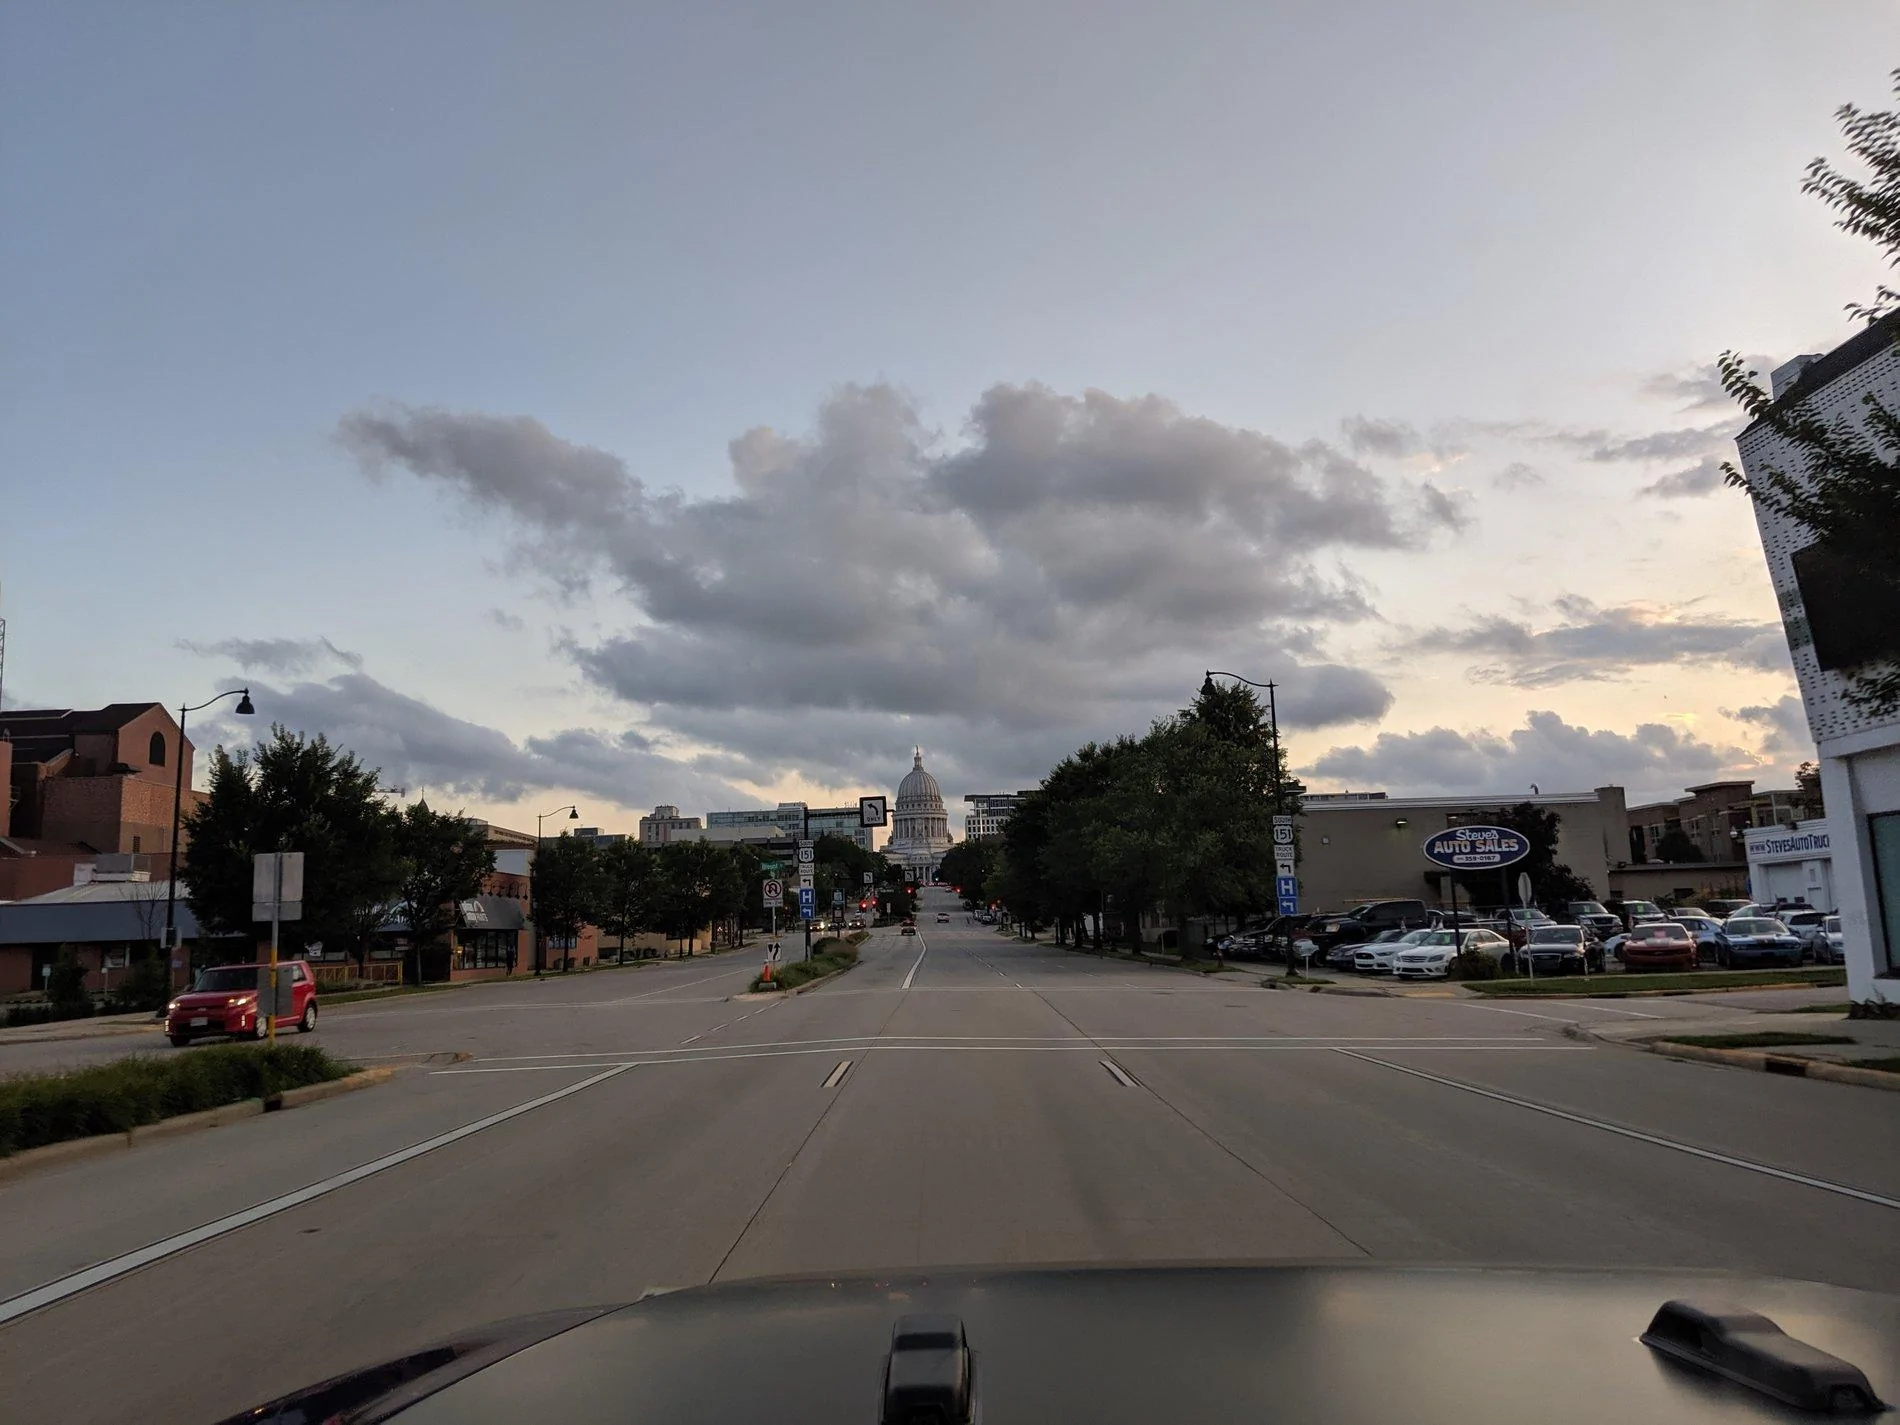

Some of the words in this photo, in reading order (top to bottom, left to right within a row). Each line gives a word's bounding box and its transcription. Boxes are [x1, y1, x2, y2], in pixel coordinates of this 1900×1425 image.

[1275, 829, 1292, 840] 151
[1456, 829, 1499, 841] Steve's
[1434, 840, 1471, 853] AUTO
[1475, 839, 1519, 852] SALES
[801, 849, 812, 859] 151
[1281, 880, 1293, 895] H
[802, 891, 812, 903] H
